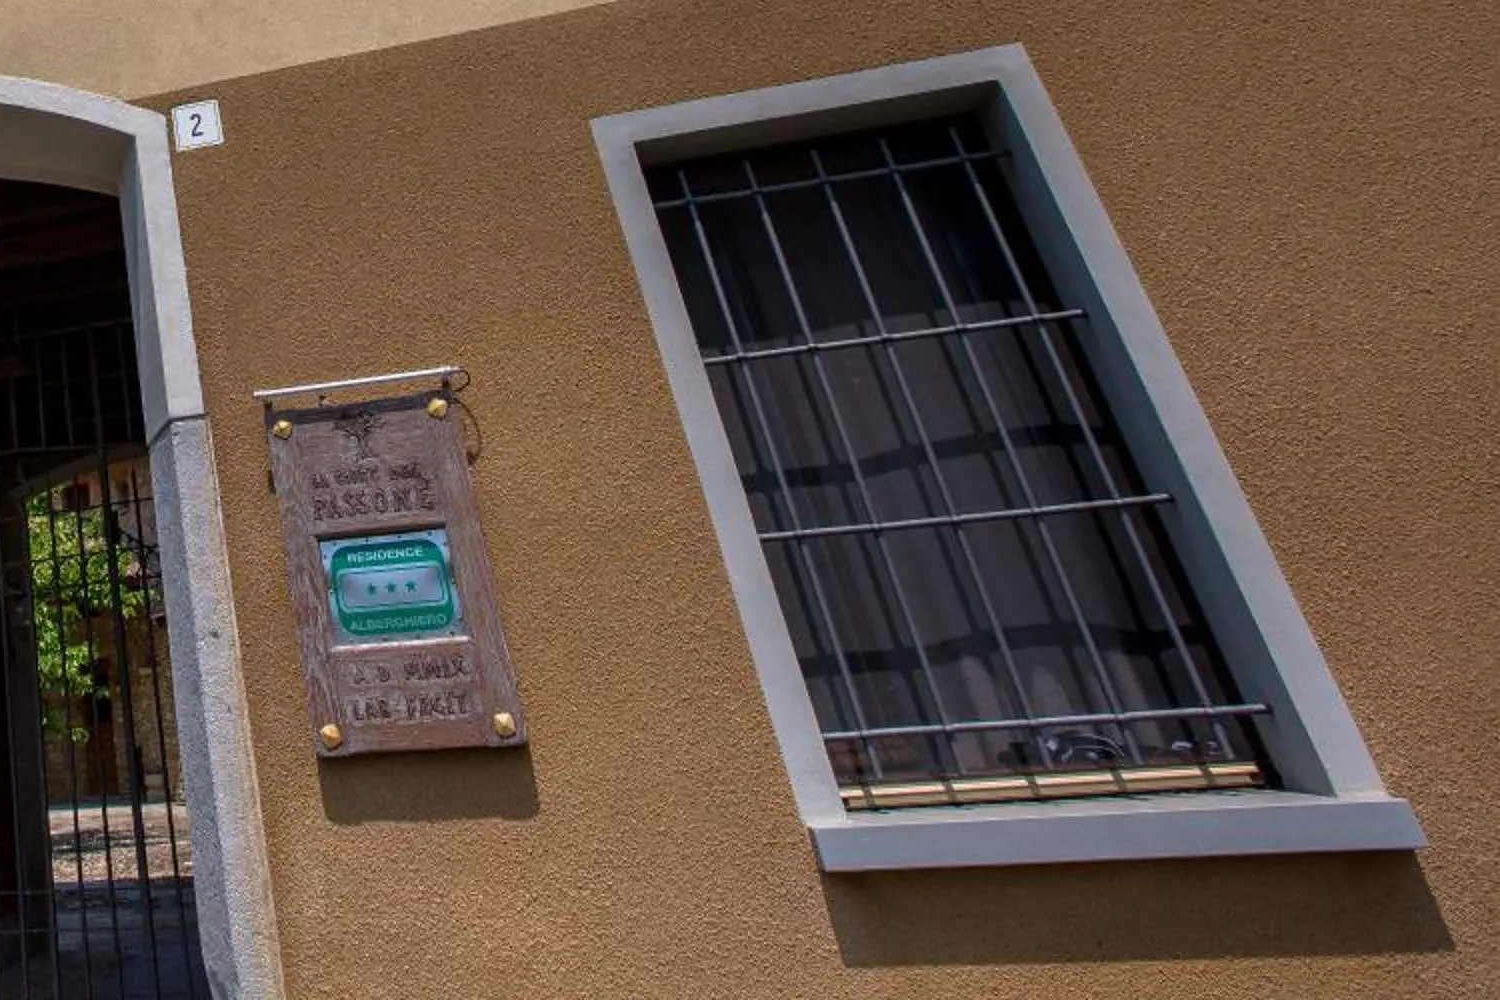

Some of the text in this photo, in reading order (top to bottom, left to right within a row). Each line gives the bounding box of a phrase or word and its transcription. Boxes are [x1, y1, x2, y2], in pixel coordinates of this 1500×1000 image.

[190, 113, 204, 137] 2
[347, 544, 425, 563] RESIDENCE
[349, 614, 447, 632] ALBERGHIERO
